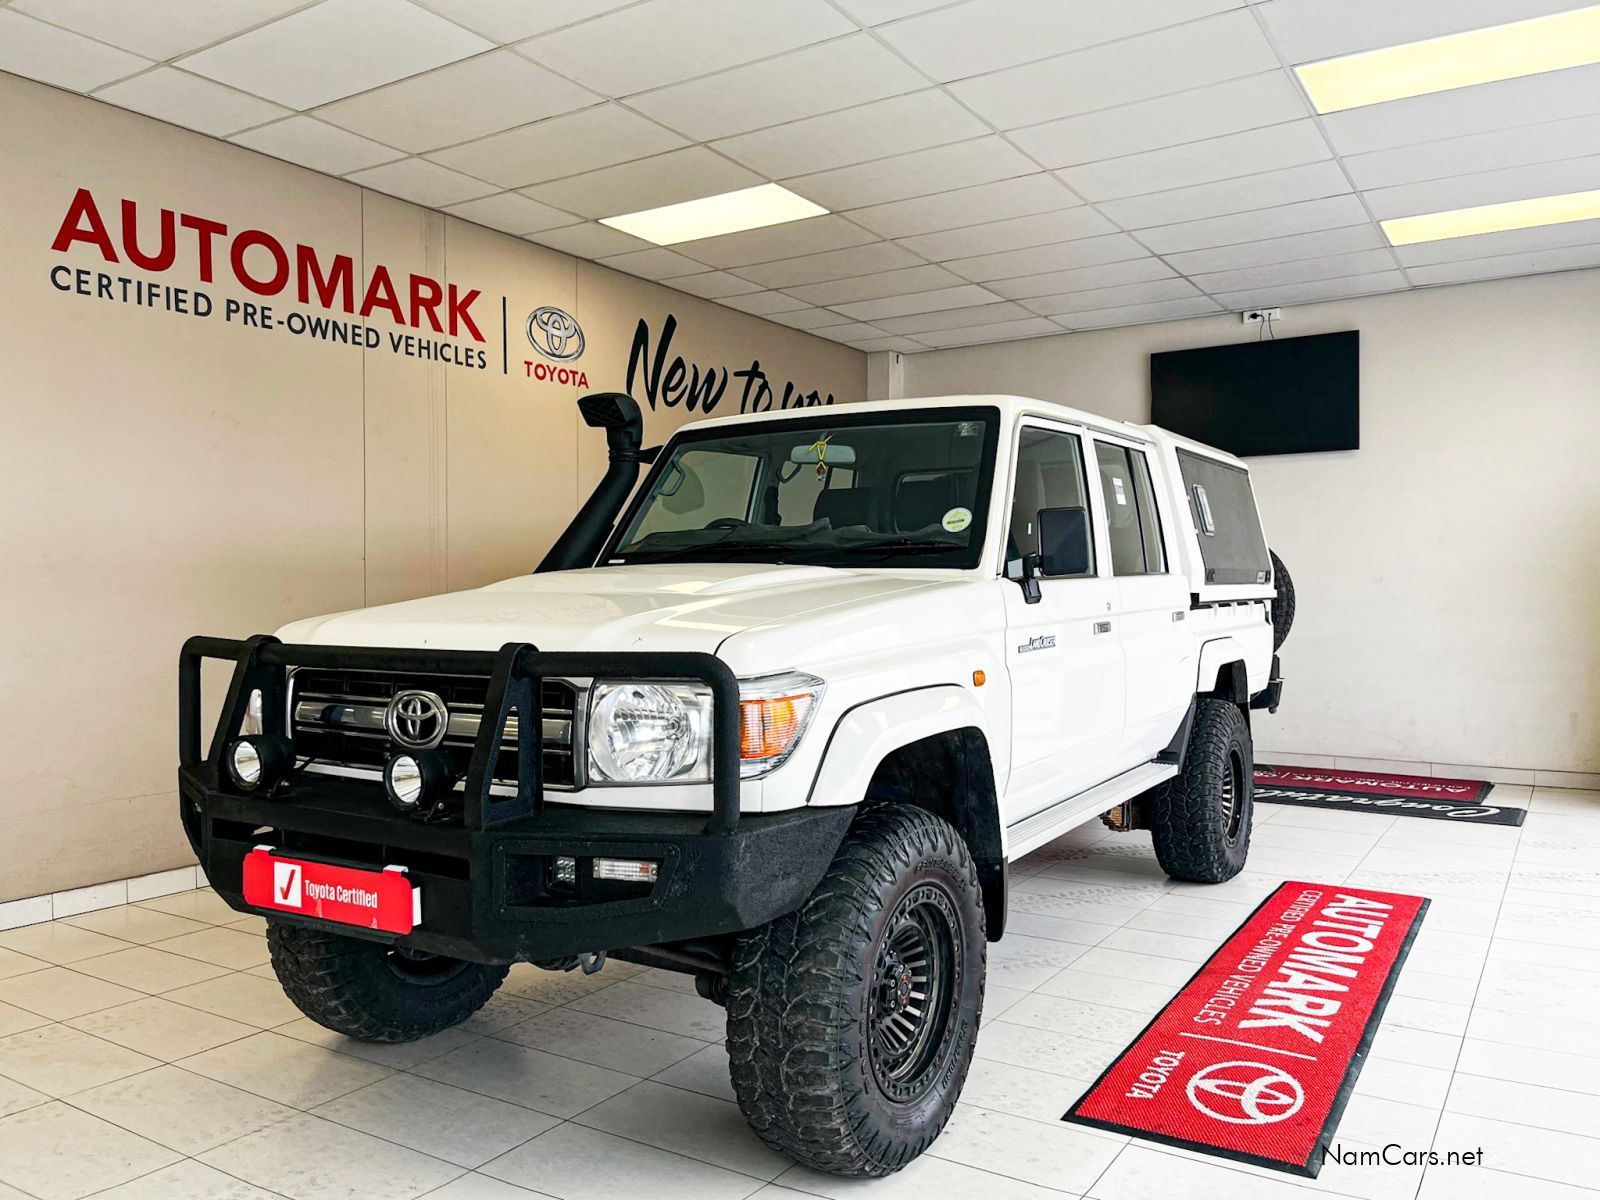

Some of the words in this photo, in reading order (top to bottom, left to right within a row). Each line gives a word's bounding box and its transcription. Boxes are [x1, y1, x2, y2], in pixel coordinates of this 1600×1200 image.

[51, 188, 486, 343] AUTOMARK
[50, 265, 212, 317] CERTIFIED
[225, 299, 380, 349] PRE-OWNED
[389, 332, 487, 369] VEHICLES
[524, 360, 589, 389] TOYOTA
[626, 314, 728, 415] New
[733, 360, 773, 414] to
[1294, 774, 1470, 793] AUTOMARK
[304, 879, 335, 901] Toyota
[336, 885, 378, 909] Certified
[1280, 889, 1323, 922] CERTIFIED
[1237, 922, 1296, 973] PRE-OWNED
[1237, 893, 1394, 1044] AUTOMARK
[1193, 974, 1256, 1025] VEHICLES
[1126, 1050, 1184, 1100] TOYOTA
